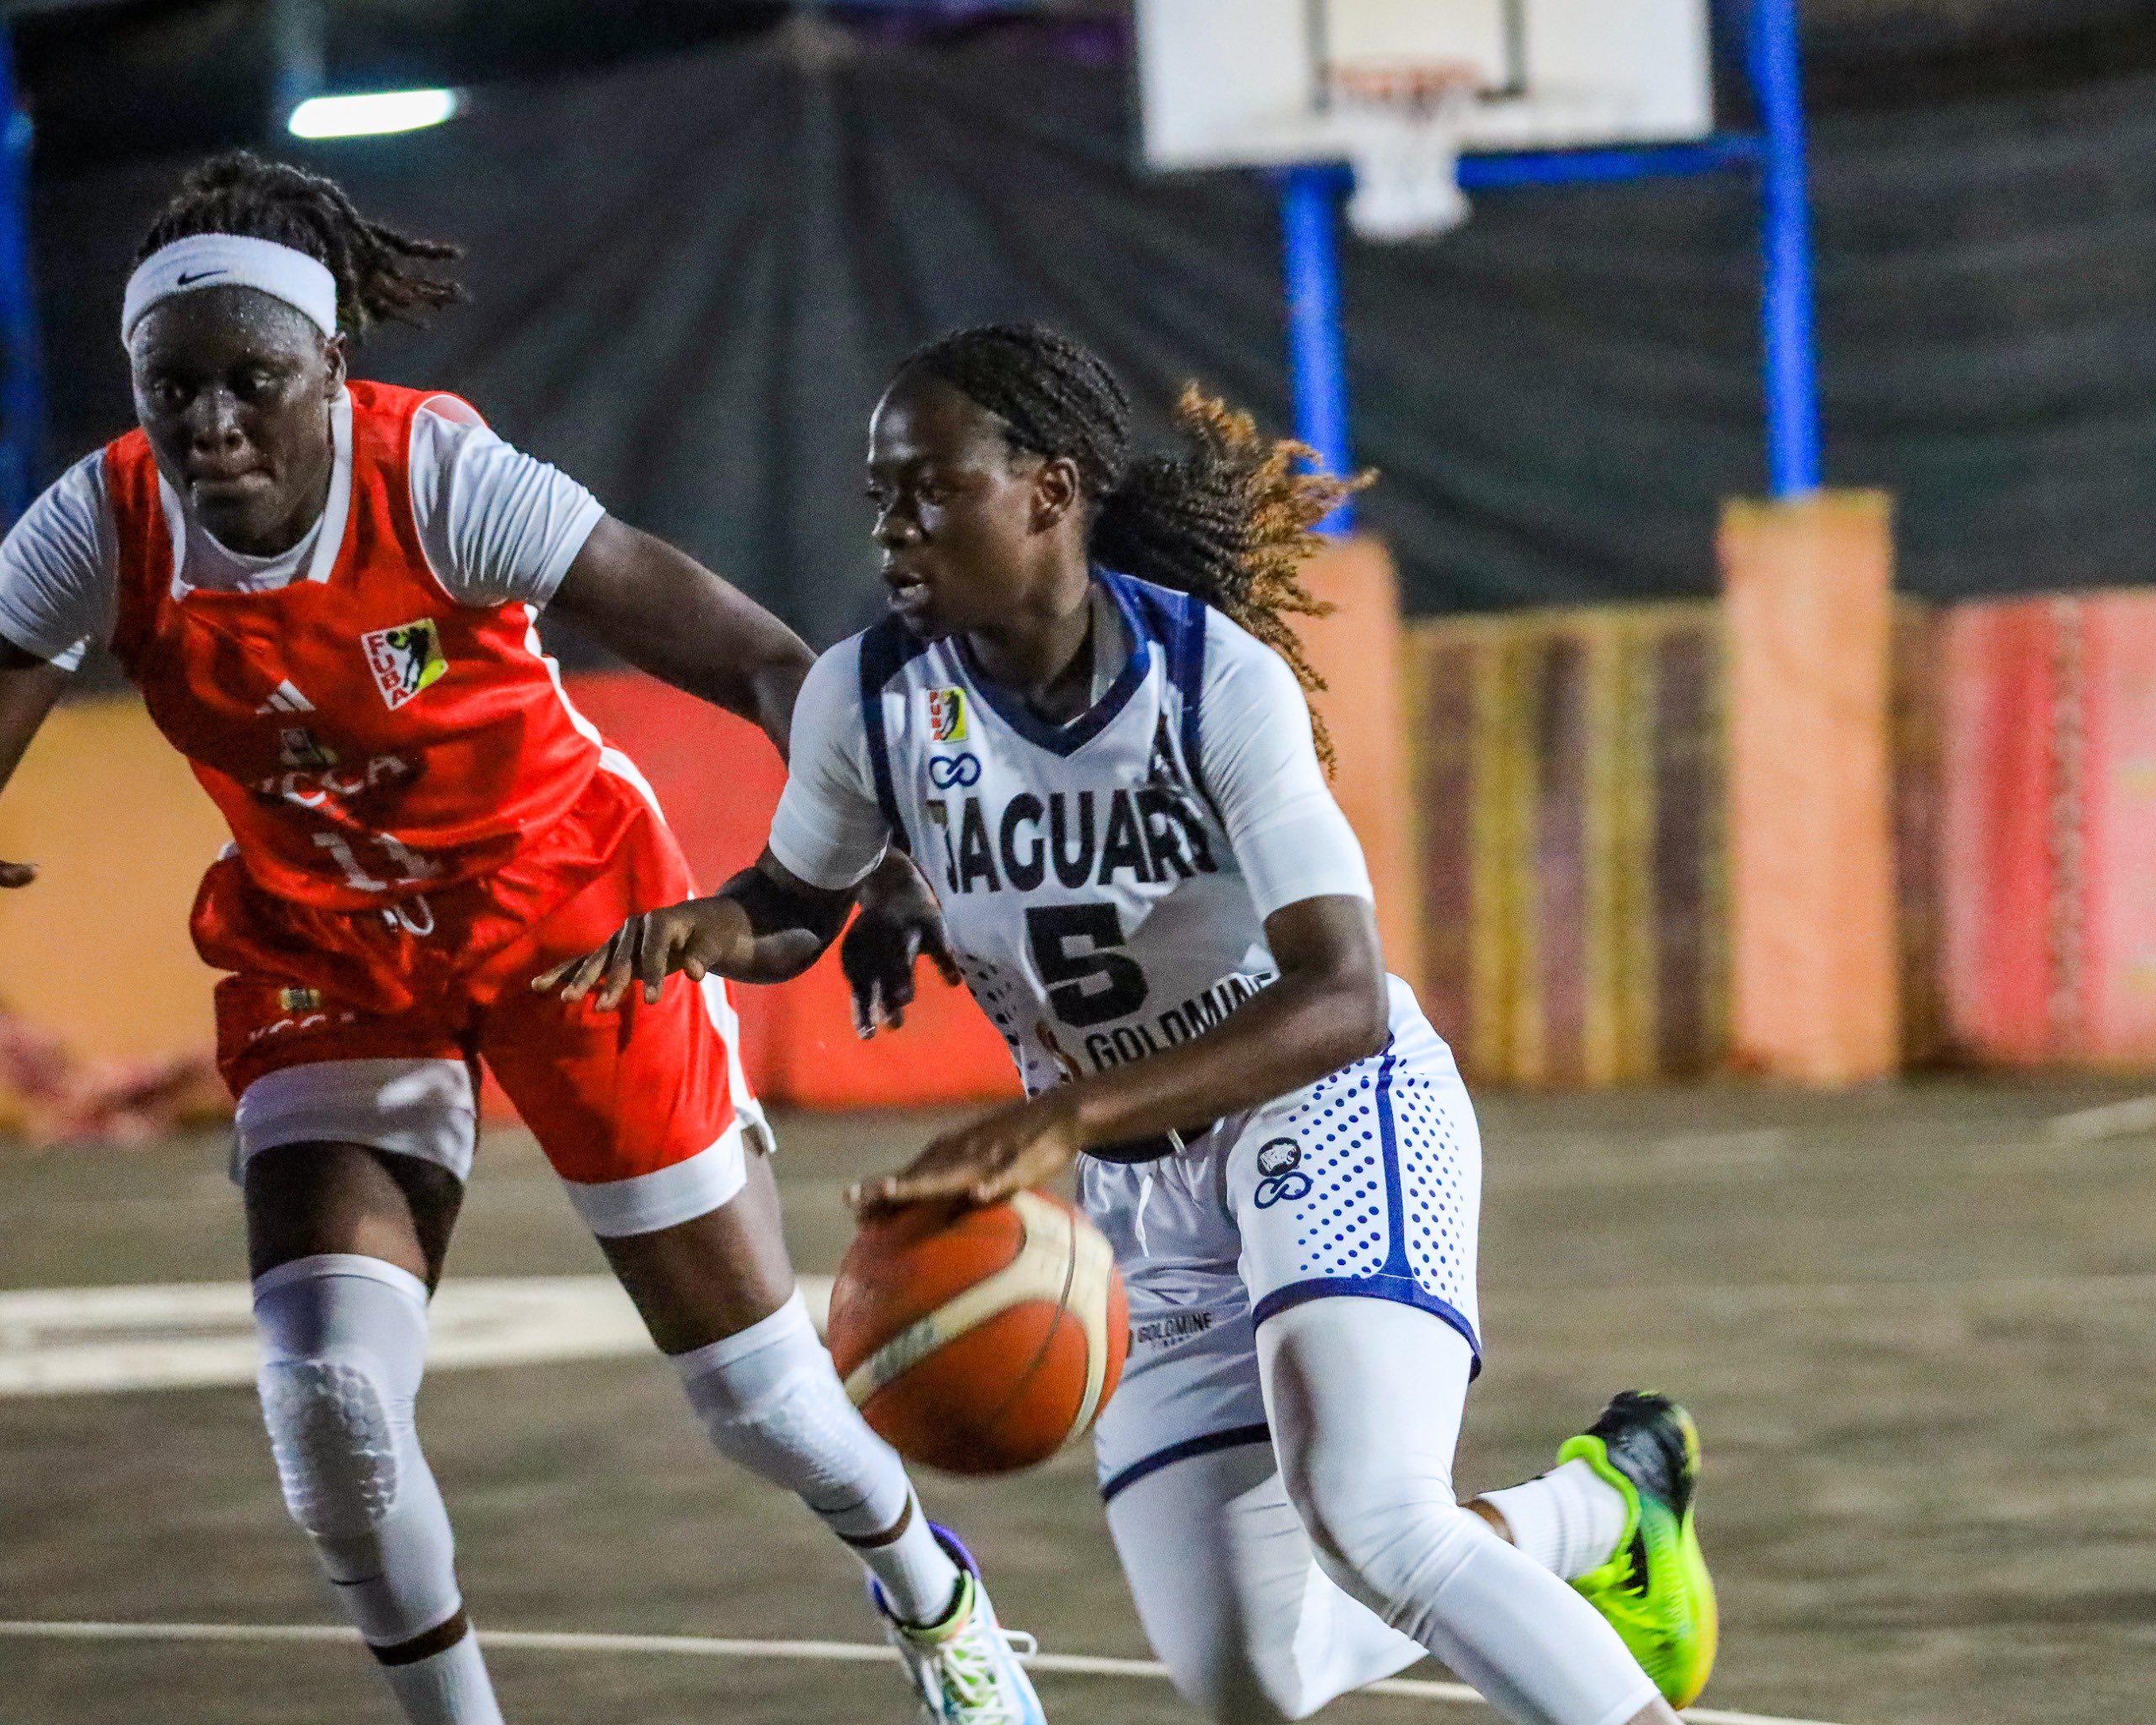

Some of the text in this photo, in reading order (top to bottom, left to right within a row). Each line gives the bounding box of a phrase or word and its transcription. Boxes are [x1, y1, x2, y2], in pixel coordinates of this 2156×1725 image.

[367, 633, 409, 707] FUBA
[259, 755, 408, 808] CCA
[1025, 902, 1150, 1028] 5
[1084, 971, 1273, 1071] GOLDMIN
